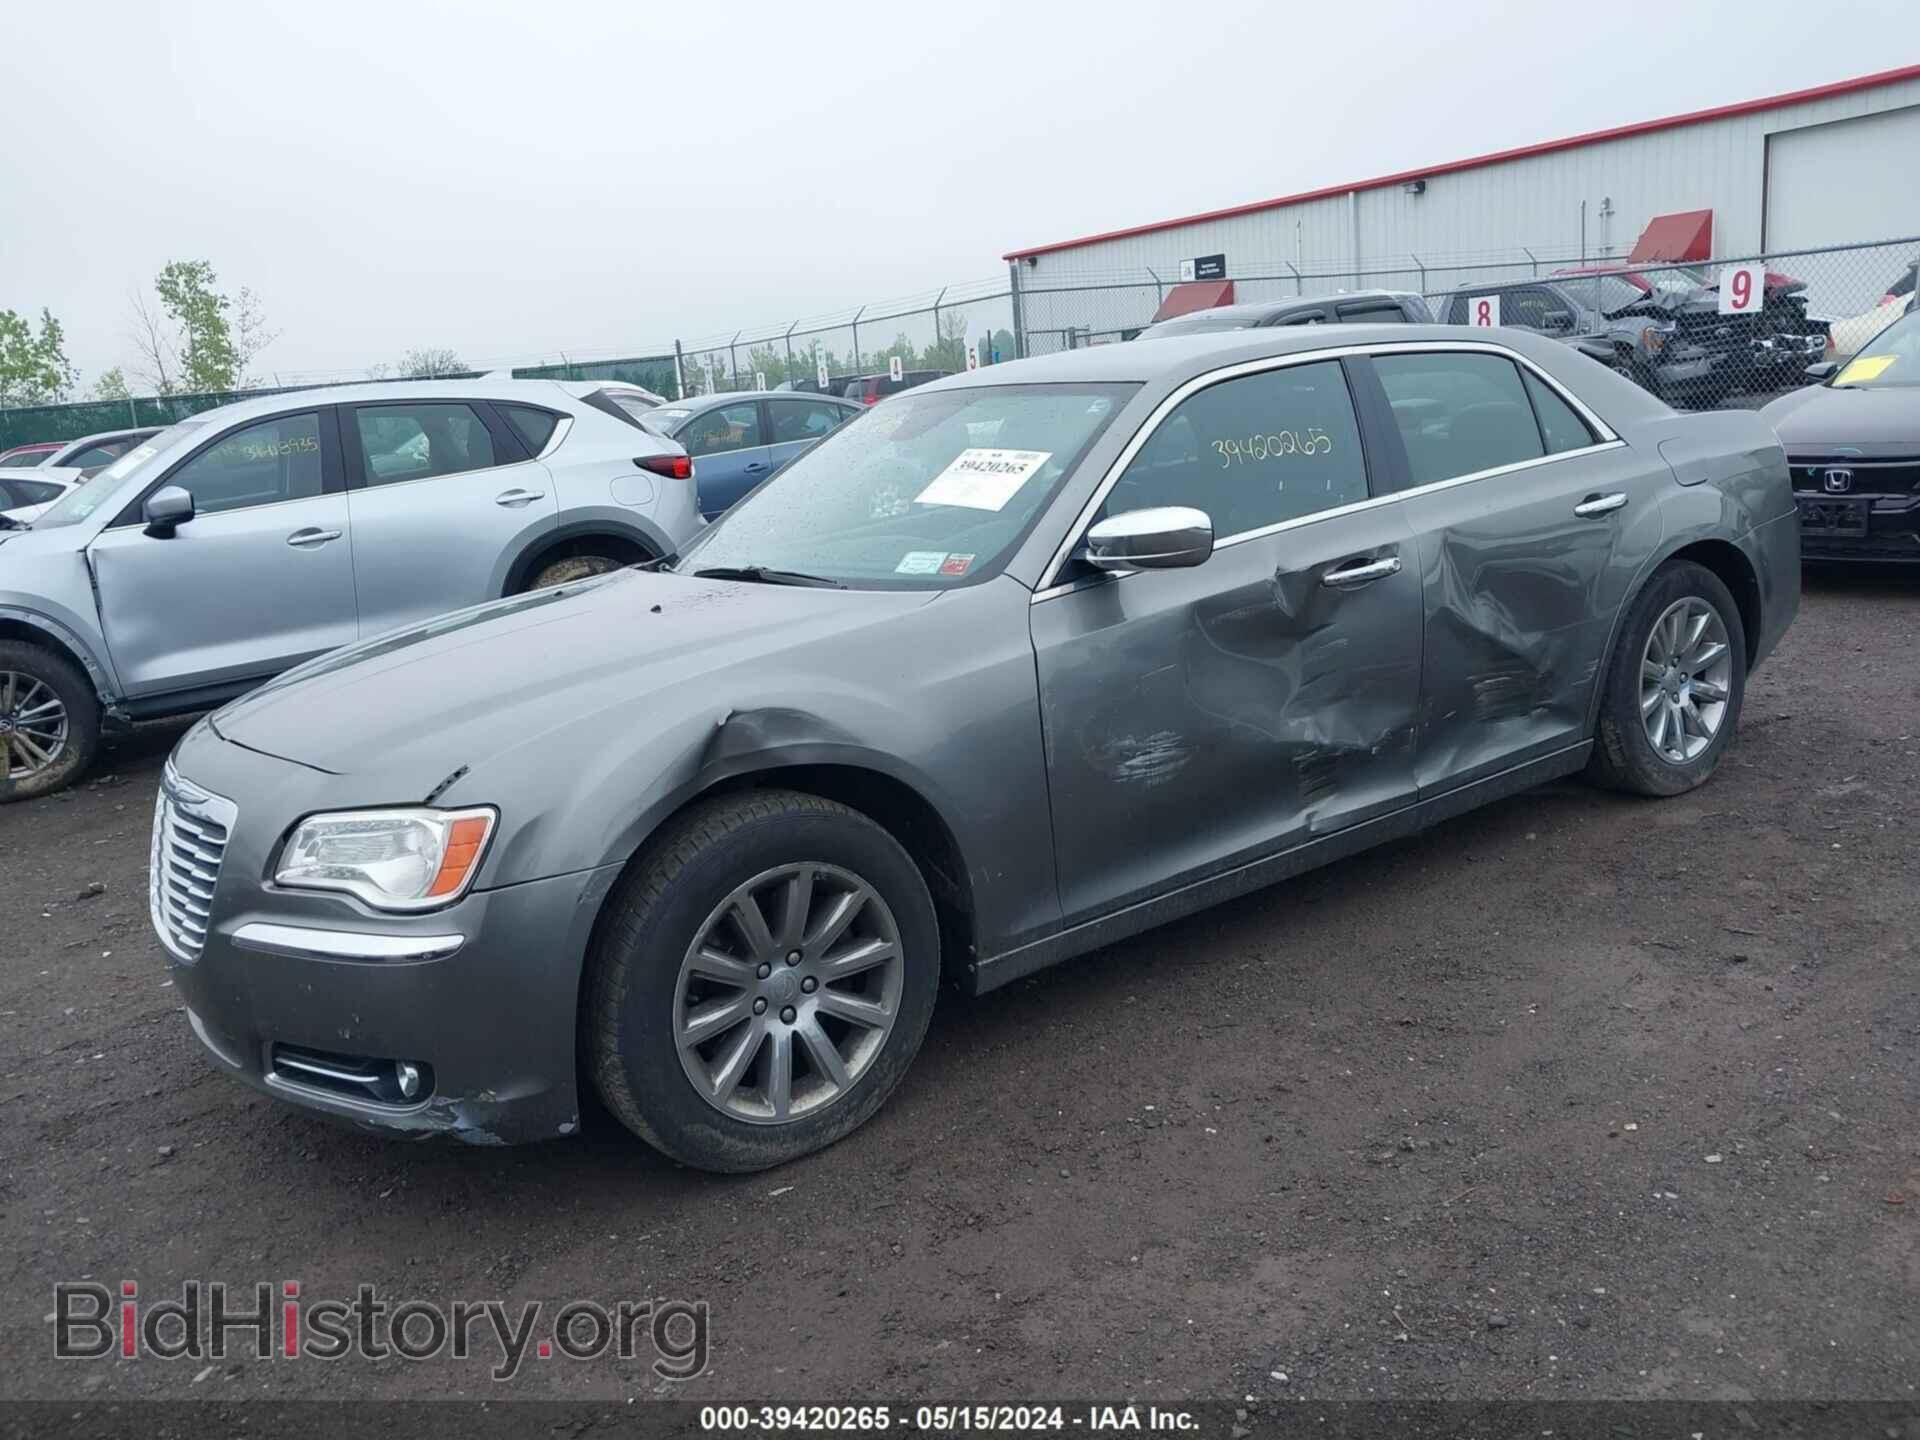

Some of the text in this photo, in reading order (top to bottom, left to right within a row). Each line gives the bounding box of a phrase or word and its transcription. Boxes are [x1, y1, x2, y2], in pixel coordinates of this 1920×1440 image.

[1731, 270, 1752, 309] 9
[1477, 300, 1491, 327] 8
[969, 347, 976, 370] 5
[1211, 427, 1332, 469] 39420265
[954, 460, 1029, 475] 39420265
